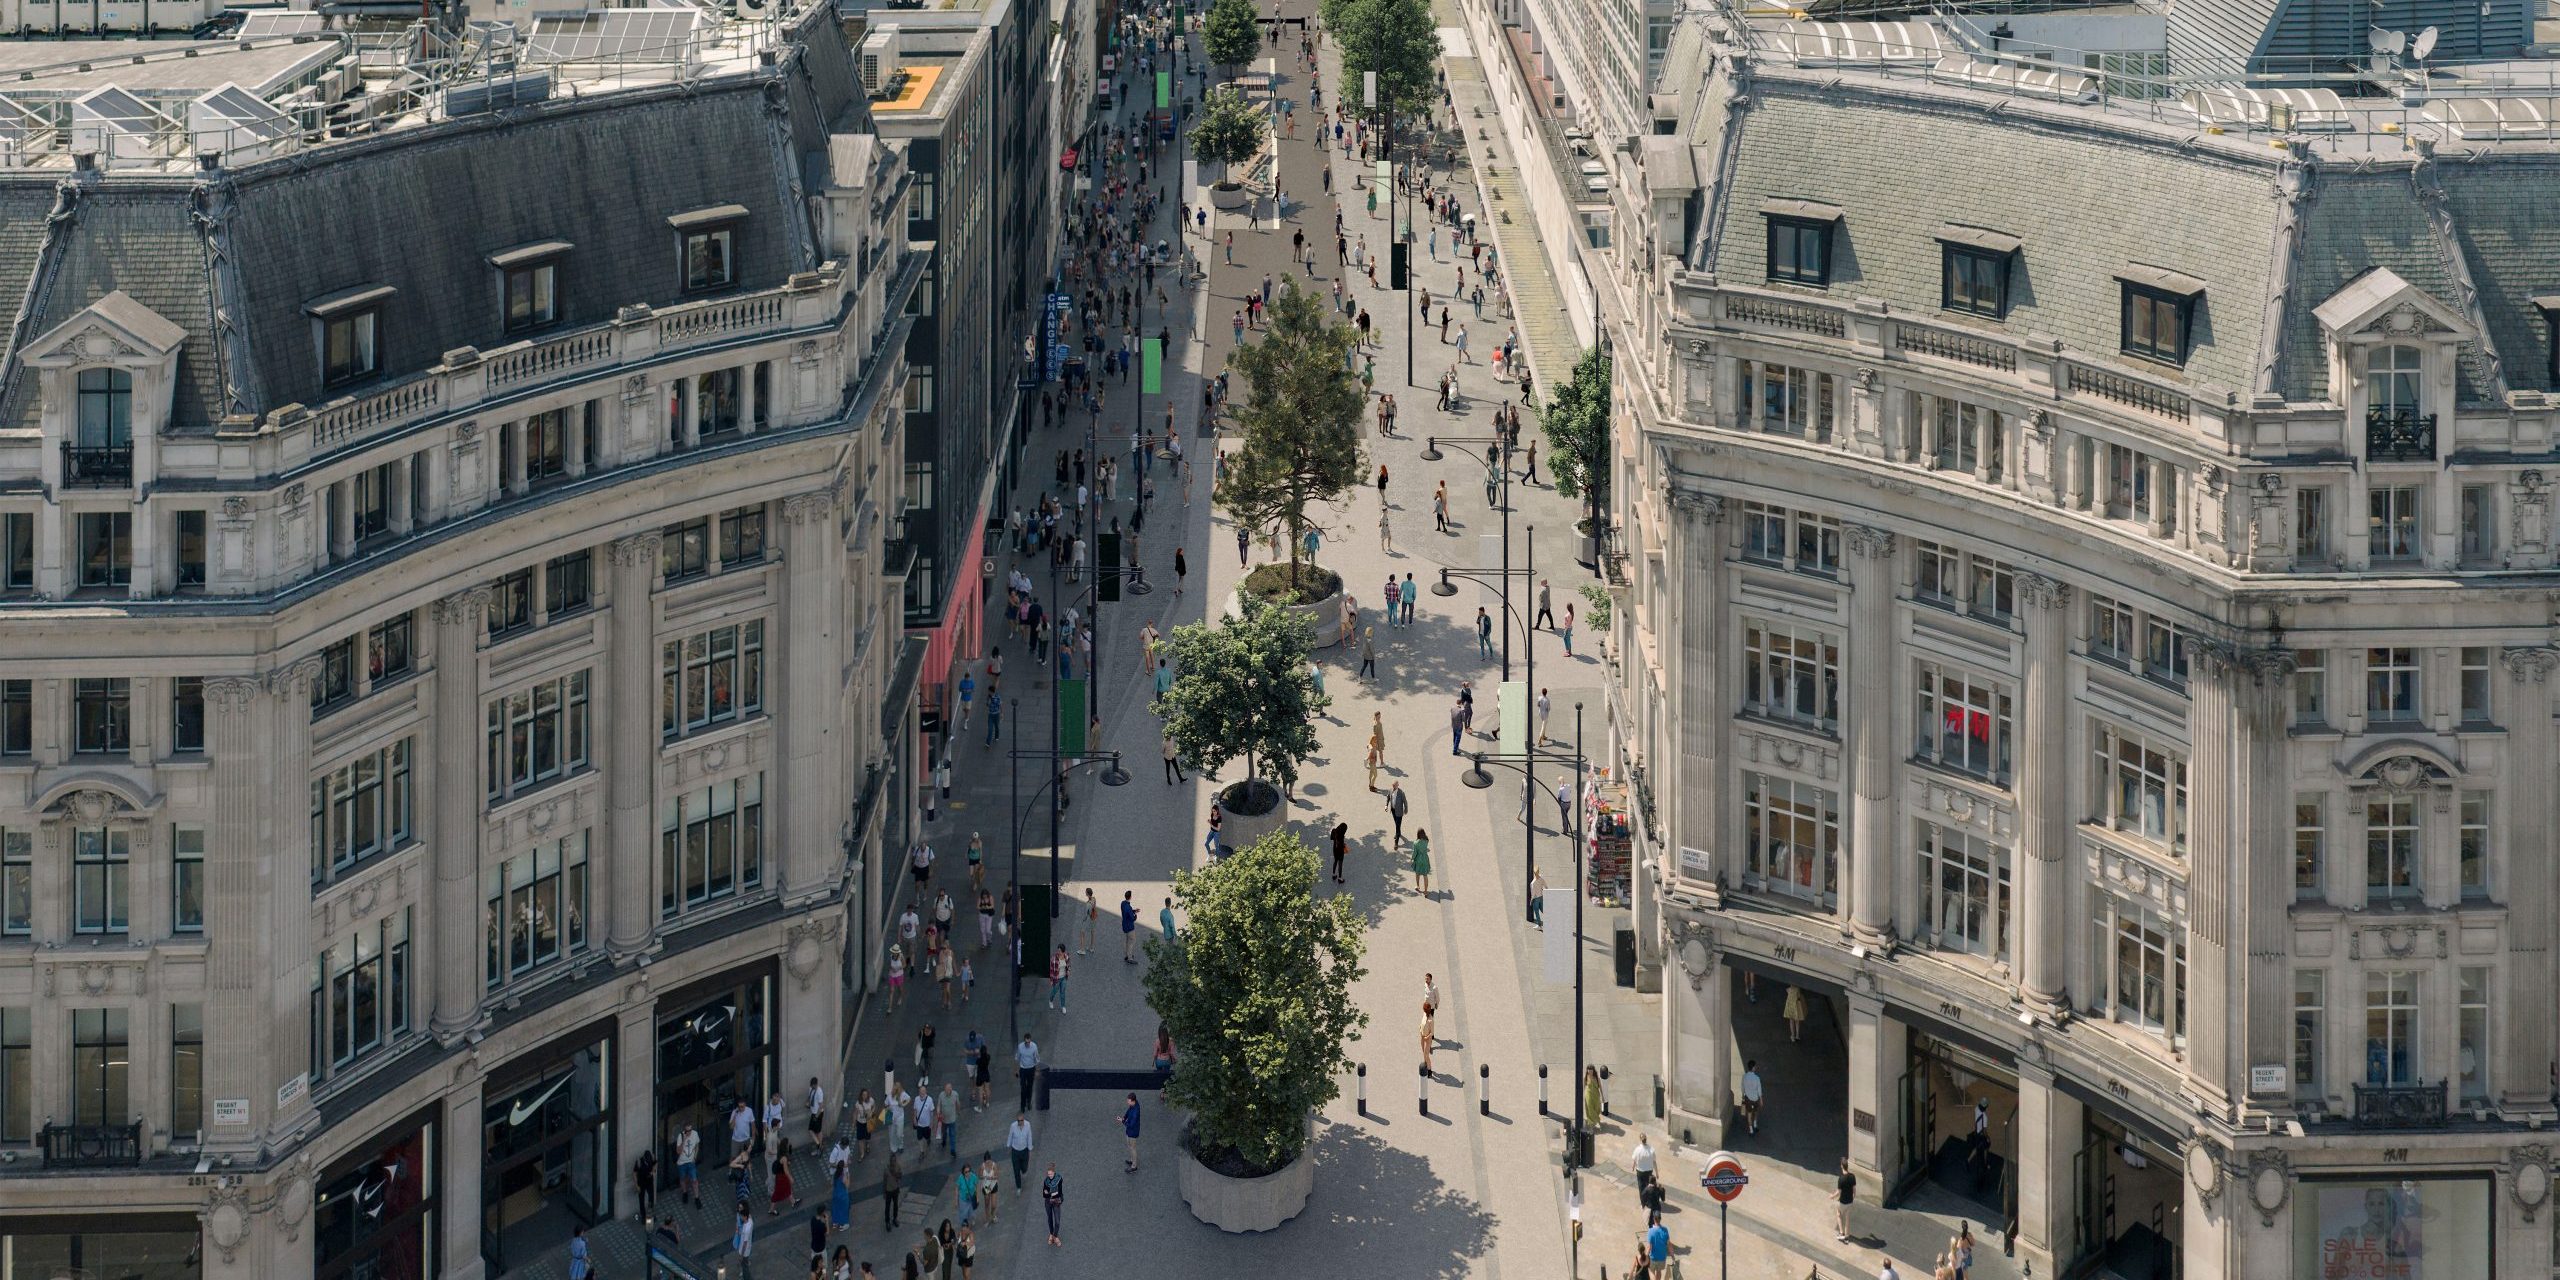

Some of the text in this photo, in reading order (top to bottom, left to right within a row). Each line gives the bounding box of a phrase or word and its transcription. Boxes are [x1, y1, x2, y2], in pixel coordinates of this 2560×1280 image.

[1047, 293, 1056, 347] CHANGE
[1946, 704, 1990, 744] HM
[1703, 1177, 1747, 1186] UNDERGROUND
[2323, 1238, 2377, 1252] SALE
[2324, 1251, 2385, 1266] UP TO
